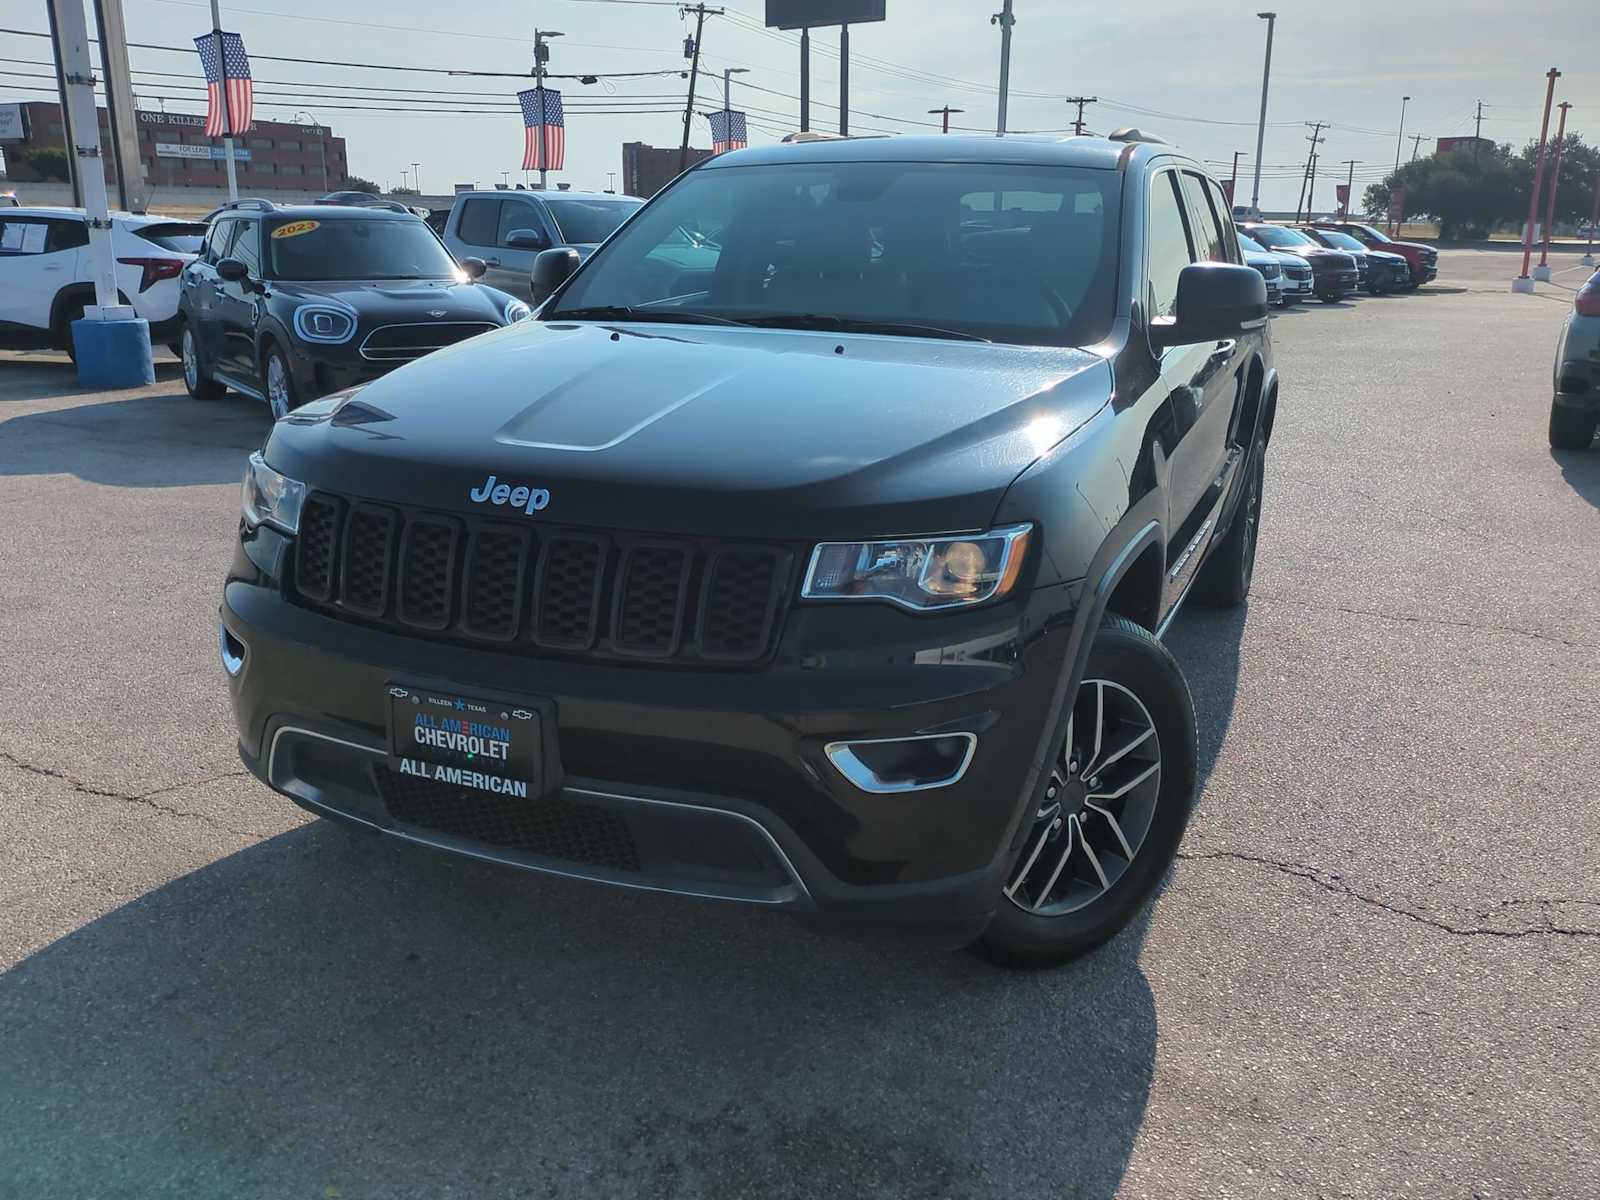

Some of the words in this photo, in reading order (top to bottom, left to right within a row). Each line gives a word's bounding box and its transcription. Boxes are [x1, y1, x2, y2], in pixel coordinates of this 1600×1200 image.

[140, 113, 165, 124] ONE
[168, 116, 208, 128] KILLEE
[277, 221, 316, 237] 2023
[470, 475, 550, 515] Jeep
[467, 703, 487, 713] TEXAS
[415, 712, 438, 728] ALL
[441, 718, 512, 742] AMERICAN
[414, 725, 510, 760] CHEVROLET
[400, 757, 432, 778] ALL
[434, 764, 528, 798] AMERICAN
